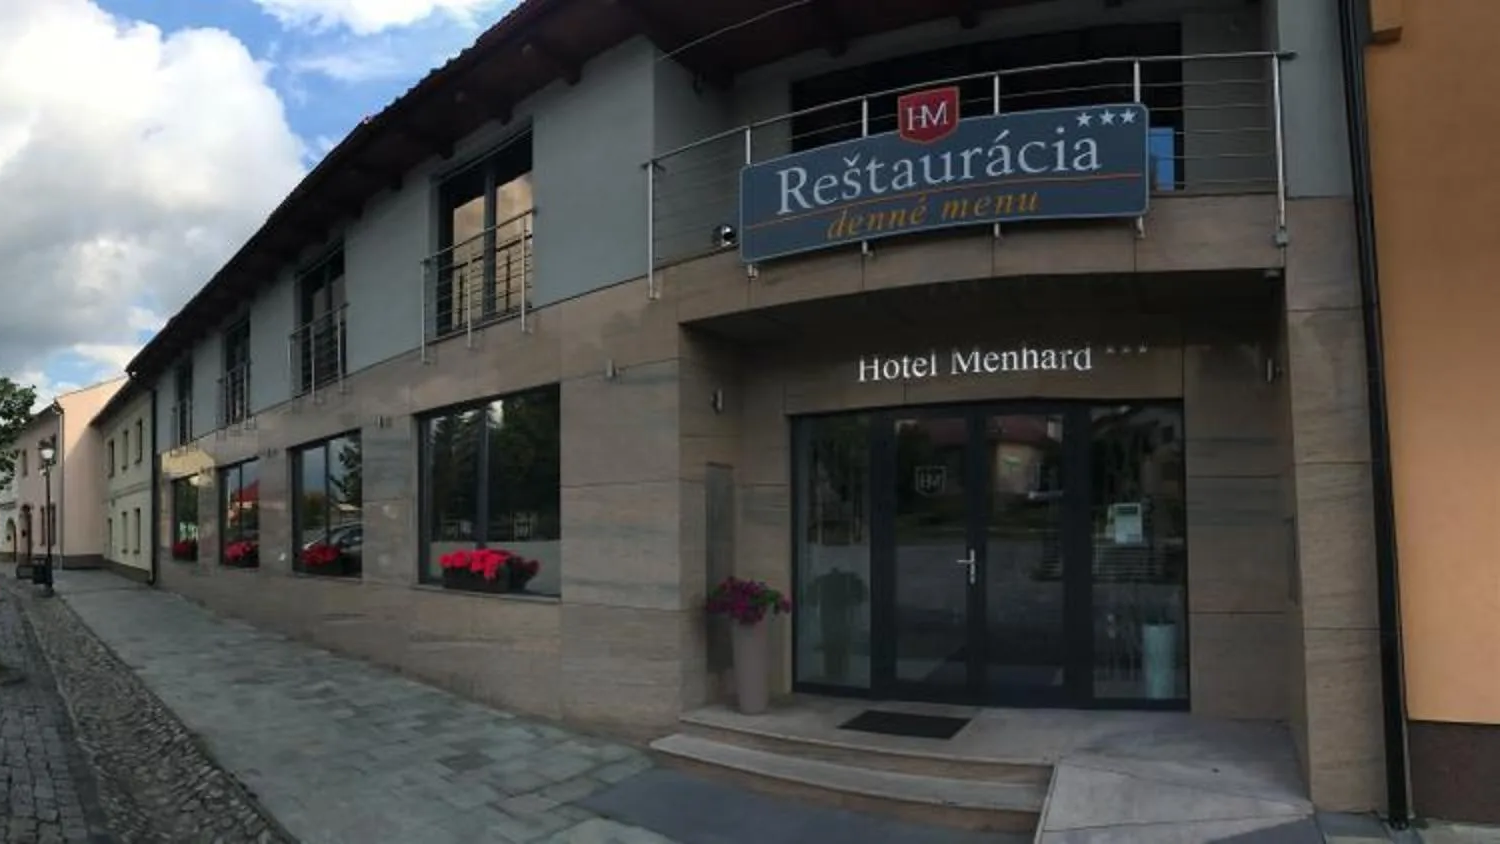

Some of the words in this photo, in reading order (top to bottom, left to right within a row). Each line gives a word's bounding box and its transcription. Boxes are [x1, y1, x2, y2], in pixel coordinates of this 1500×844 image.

[906, 101, 949, 132] HM
[775, 125, 1102, 215] Reštaurácia
[826, 194, 928, 241] denné
[940, 190, 1040, 220] menu
[857, 350, 938, 382] Hotel
[950, 346, 1092, 376] Menhard
